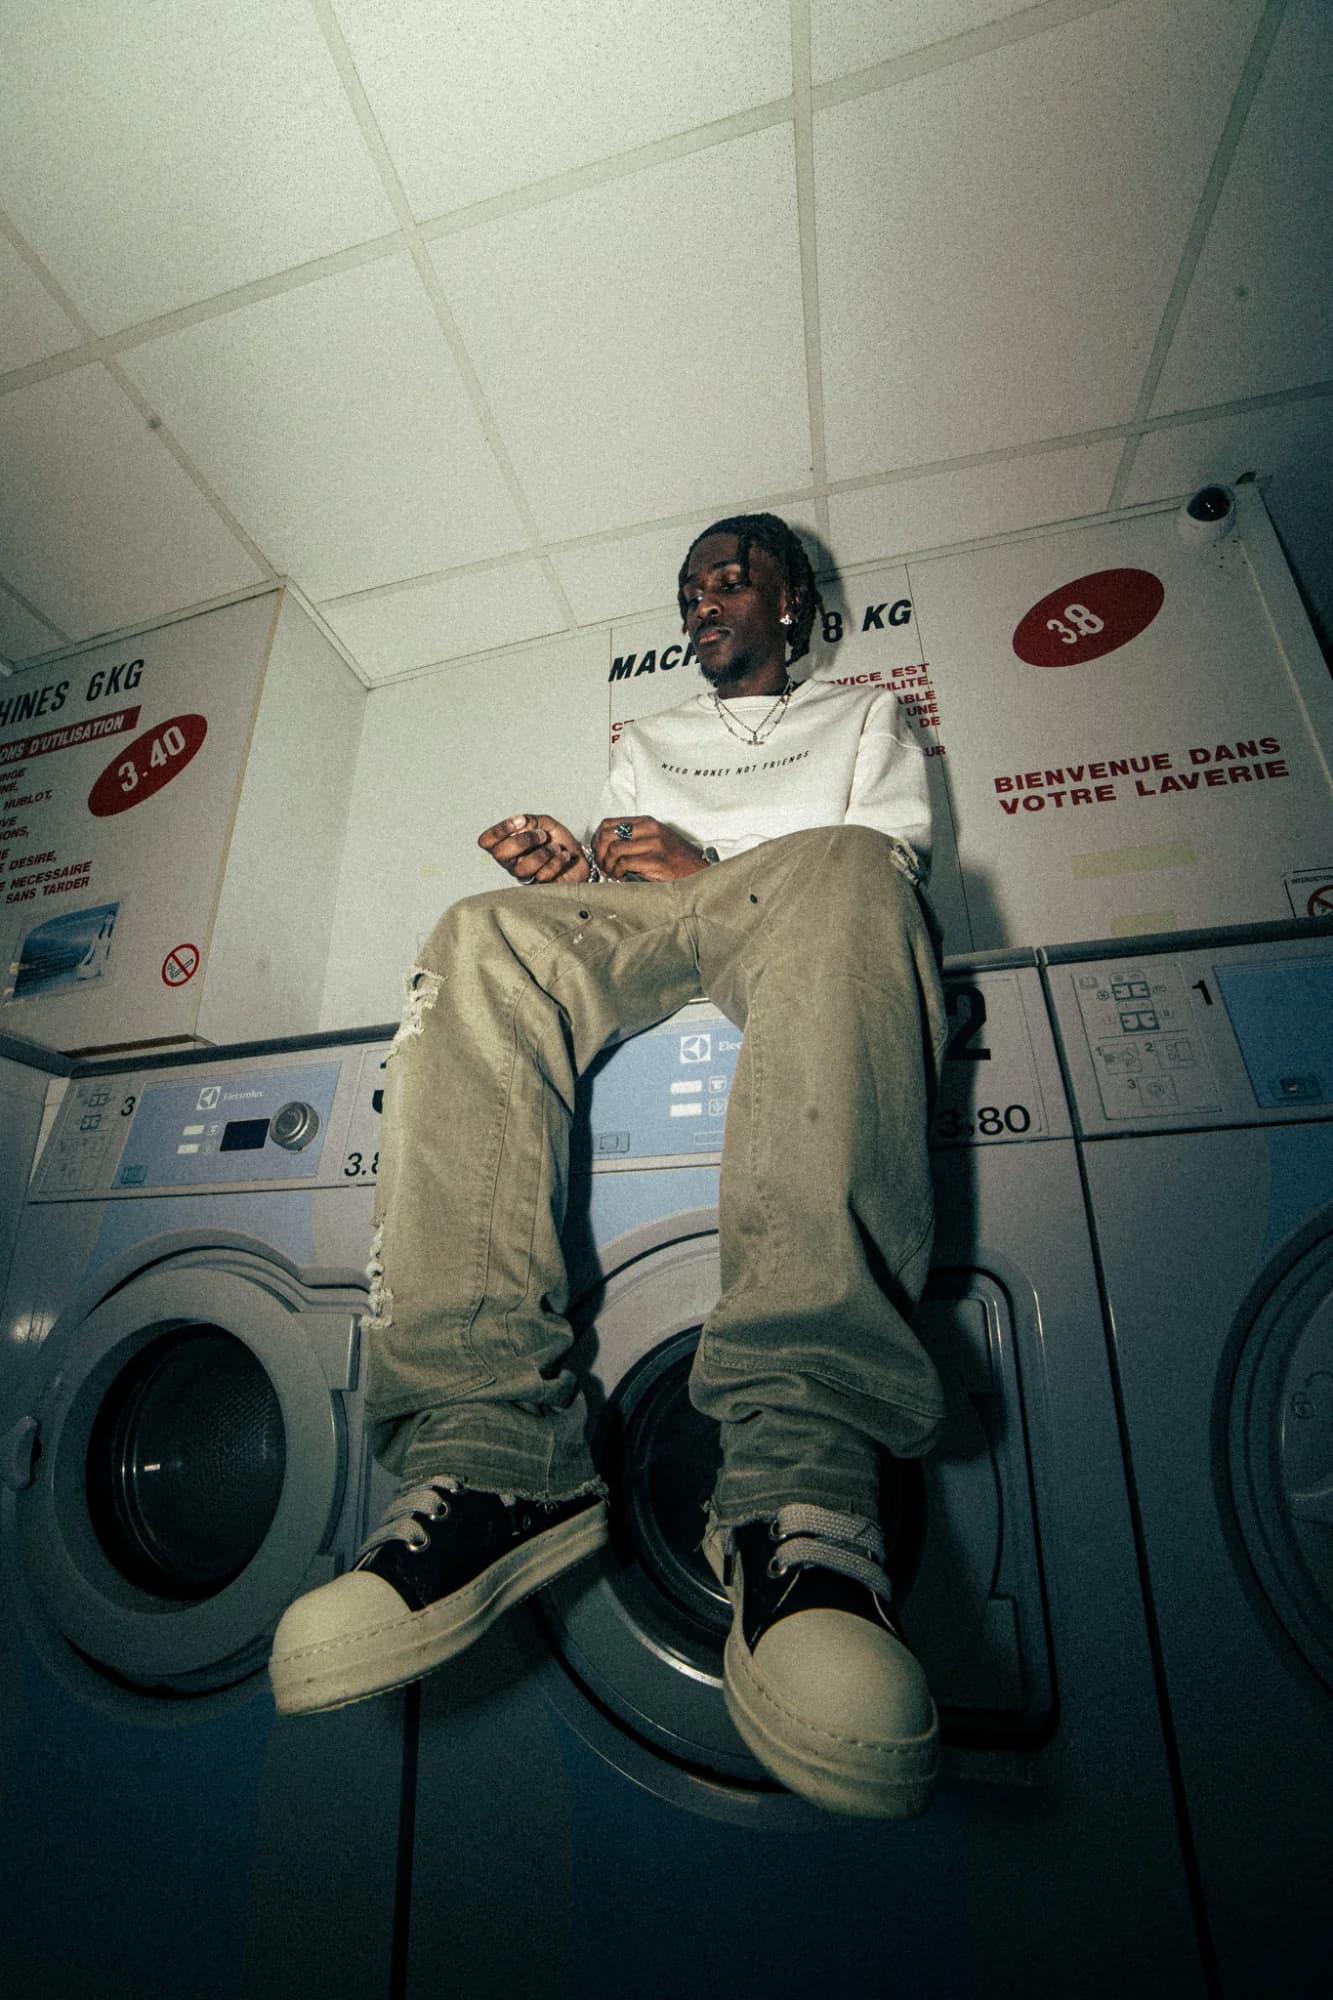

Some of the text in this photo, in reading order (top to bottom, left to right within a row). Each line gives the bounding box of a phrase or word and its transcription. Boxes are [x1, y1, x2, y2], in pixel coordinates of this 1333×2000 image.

[821, 611, 843, 643] 8
[862, 599, 912, 632] KG
[86, 659, 145, 701] 6KG
[891, 663, 930, 677] EST
[906, 703, 938, 717] UNE
[919, 716, 941, 728] DE
[29, 713, 125, 755] D'UTILISATION
[118, 726, 186, 792] 3.40
[661, 750, 809, 777] NEED MONEY NOT FRIENDS
[994, 737, 1281, 794] BIENVENUE DANS
[999, 760, 1290, 815] VOTRE LAVERIE
[9, 850, 57, 870] DESIRE,
[10, 861, 92, 890] NECESSAIRE
[6, 876, 89, 904] SANS TARDER
[1192, 980, 1213, 1005] 1
[945, 986, 991, 1060] 2
[121, 1096, 136, 1116] 3
